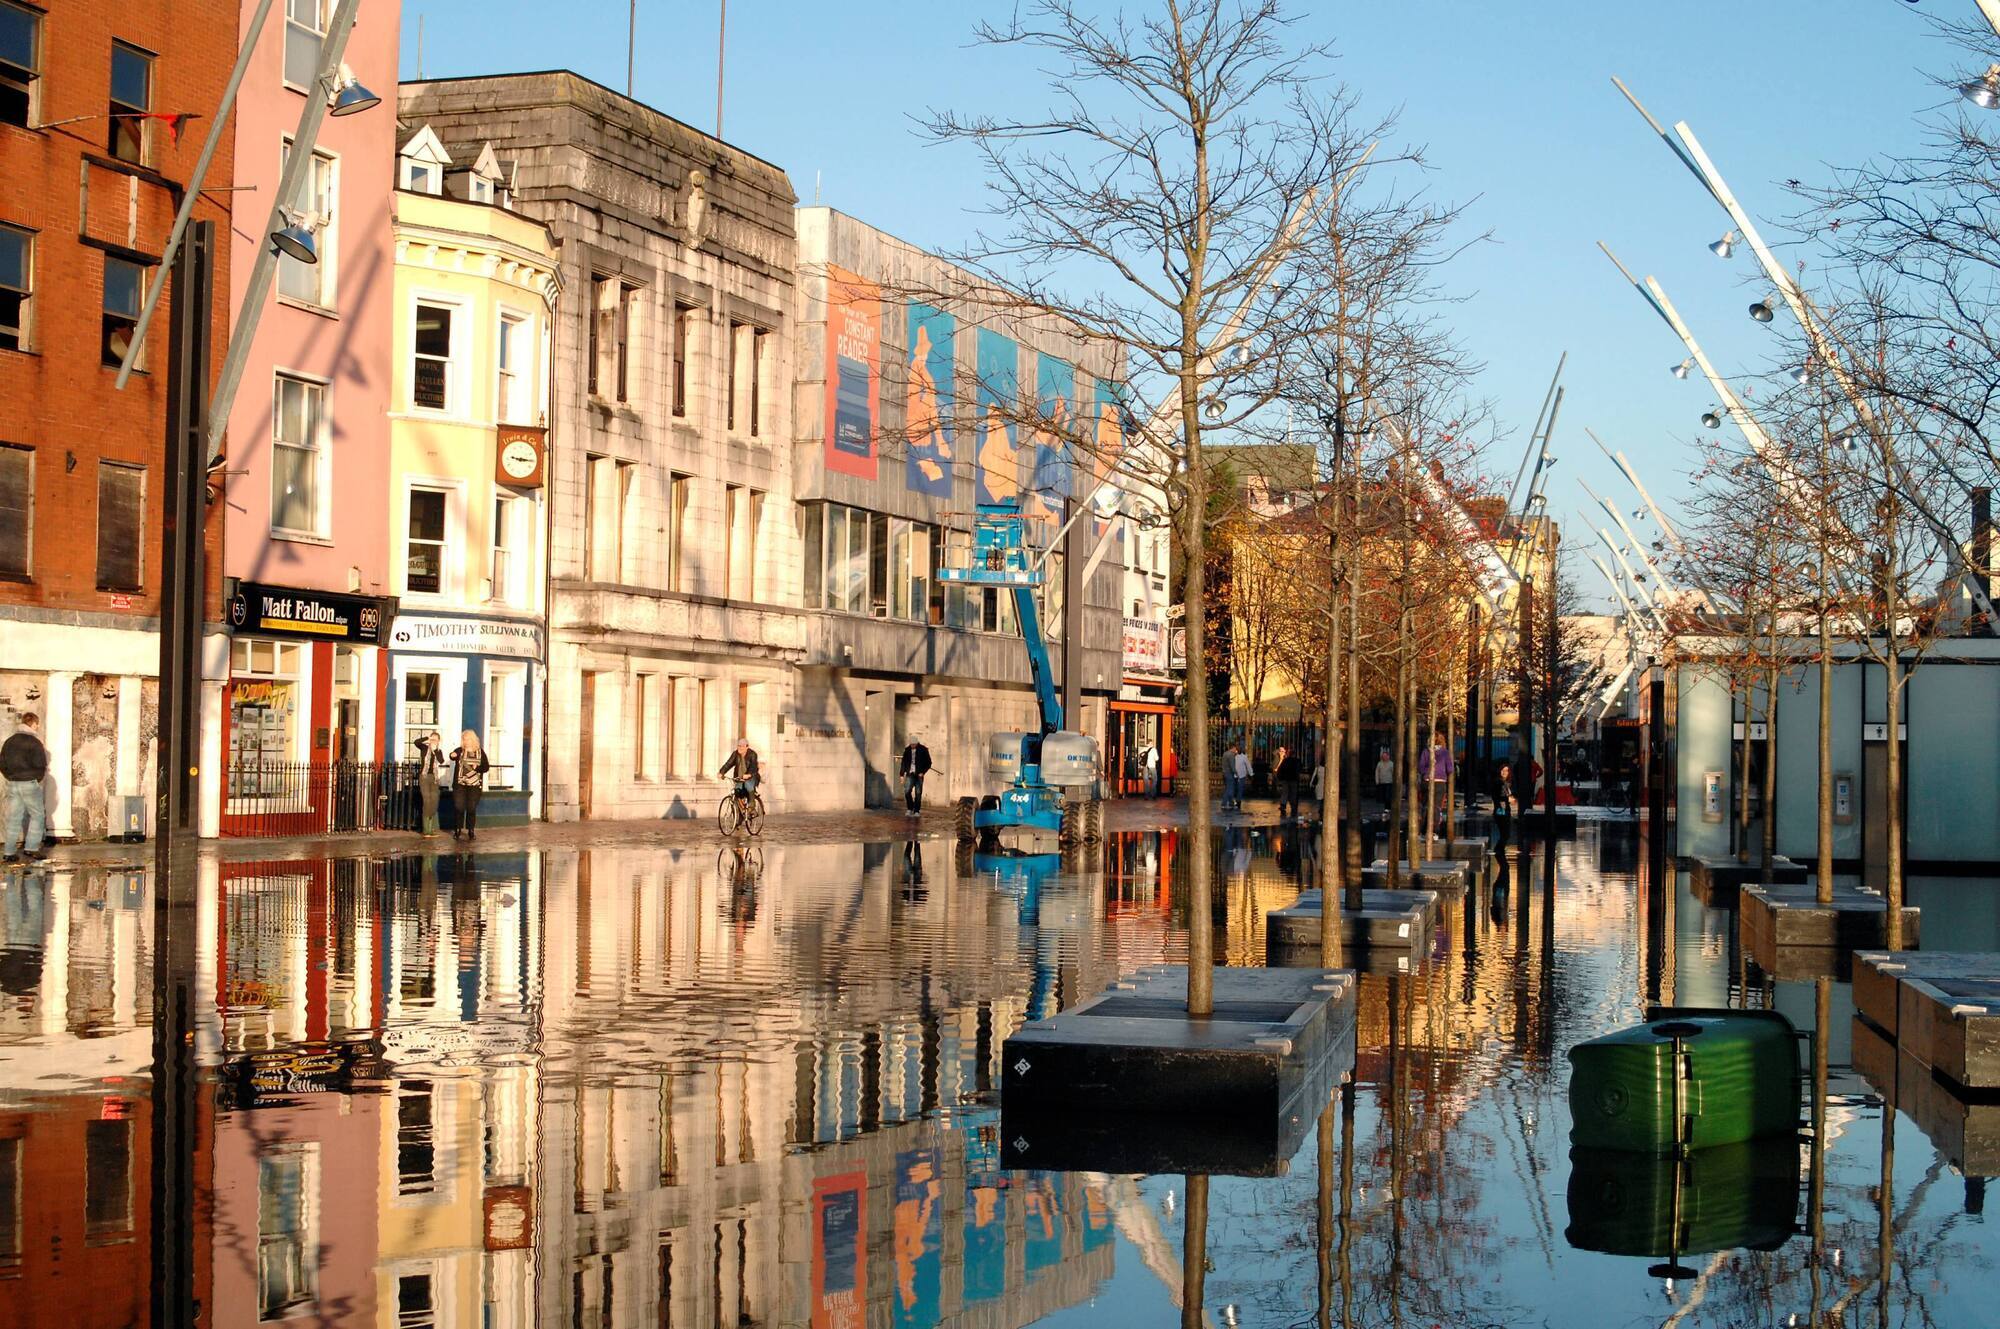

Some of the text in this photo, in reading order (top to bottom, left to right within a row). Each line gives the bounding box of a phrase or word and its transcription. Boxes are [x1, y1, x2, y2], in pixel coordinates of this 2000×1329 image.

[837, 334, 869, 365] READER
[234, 603, 246, 617] 55
[262, 596, 335, 623] Matt Fallon
[414, 624, 477, 638] TIMOTHY
[480, 624, 520, 637] SULLIVAN
[521, 628, 528, 637] &
[1010, 793, 1029, 803] 4x4
